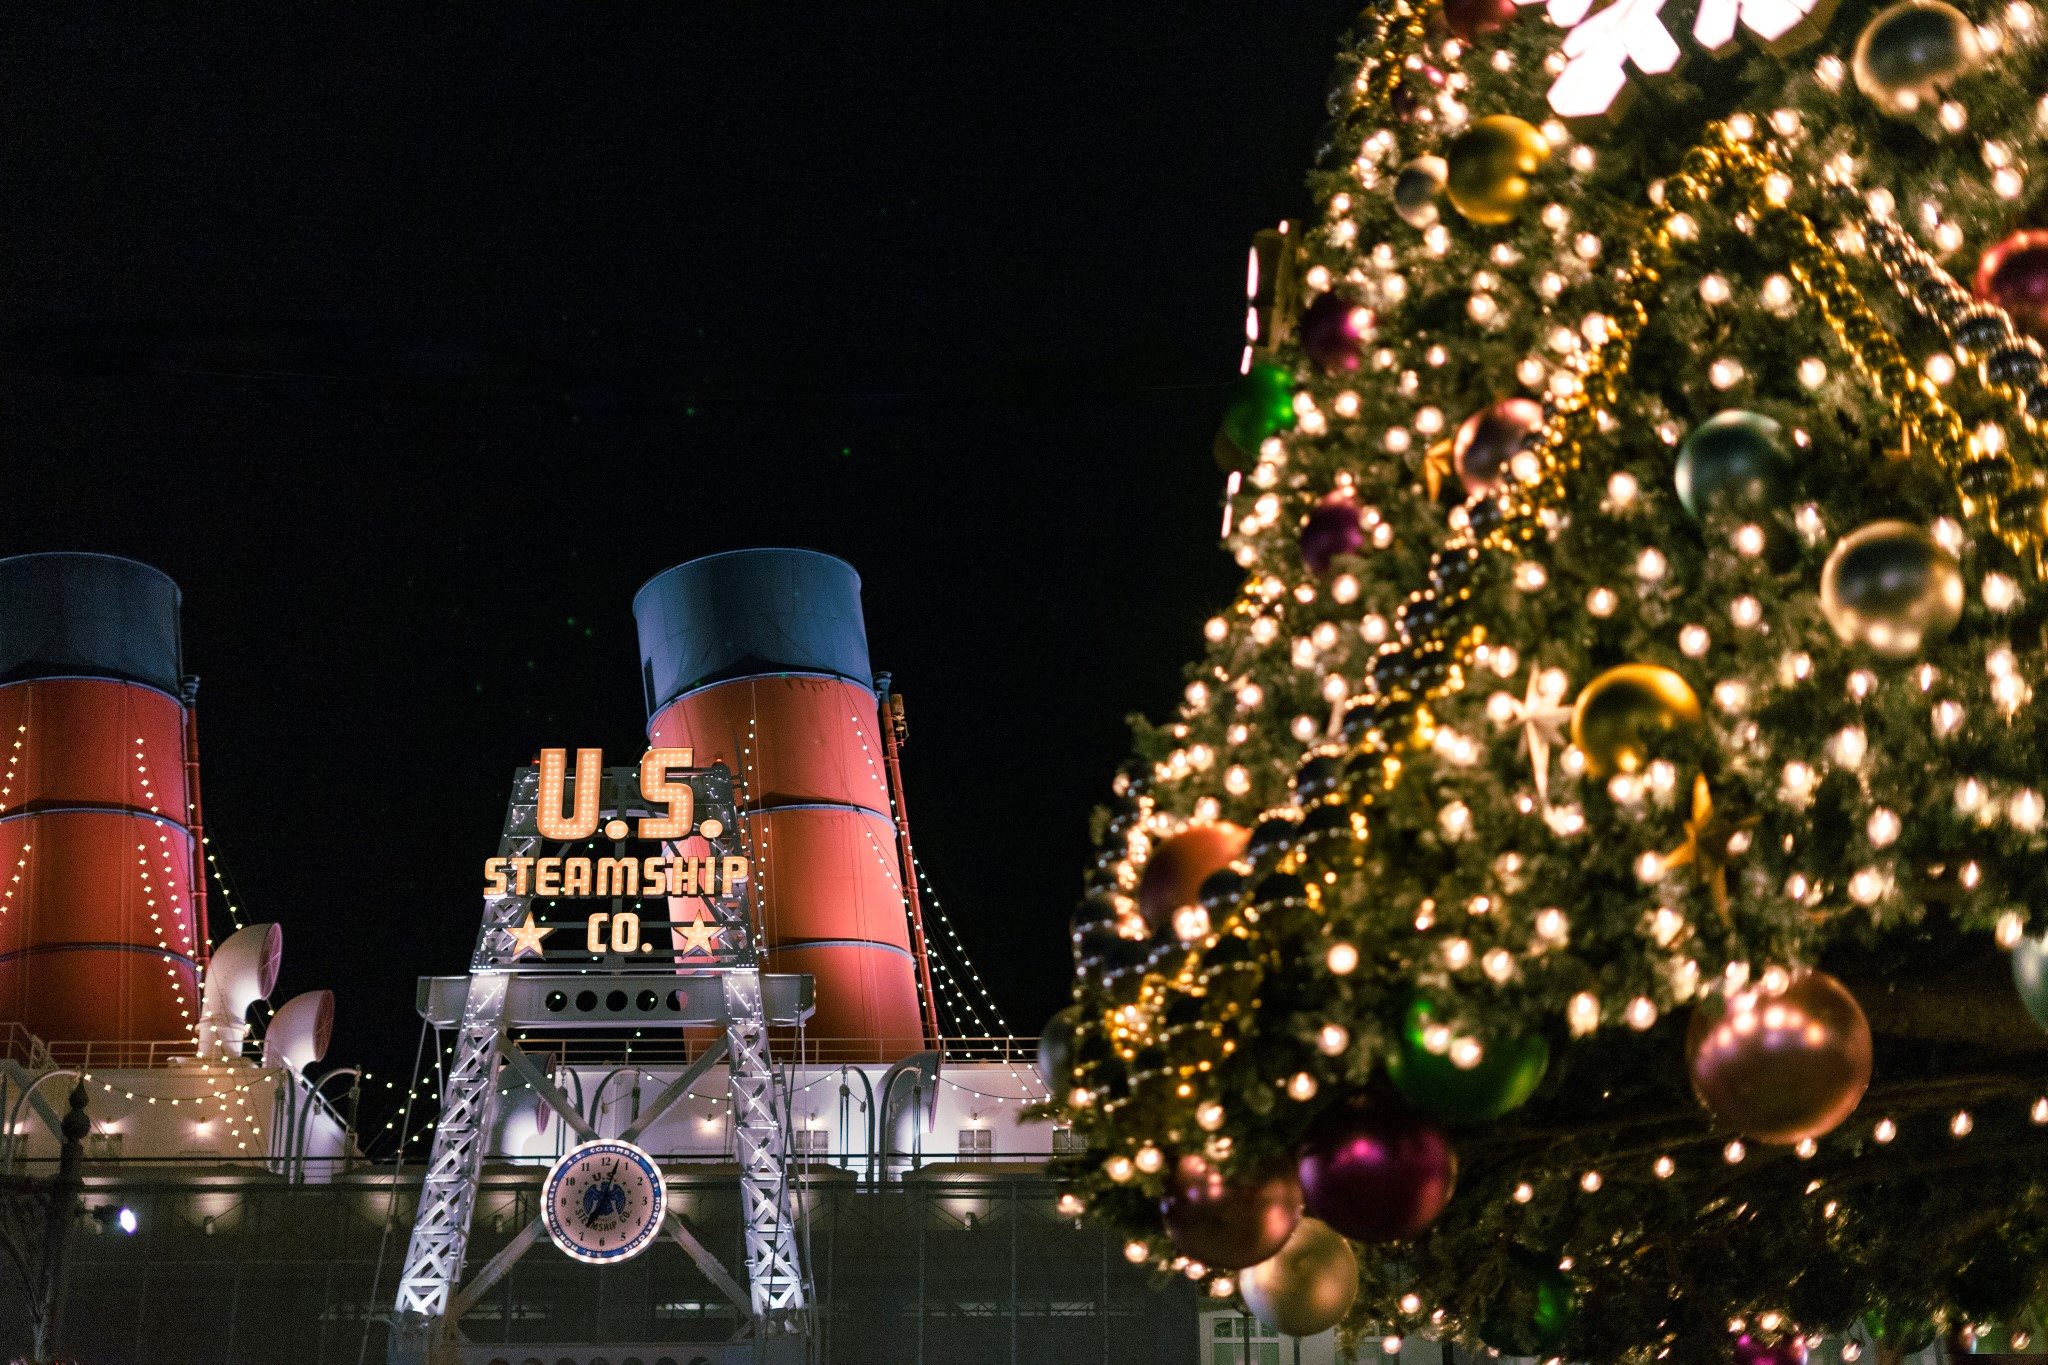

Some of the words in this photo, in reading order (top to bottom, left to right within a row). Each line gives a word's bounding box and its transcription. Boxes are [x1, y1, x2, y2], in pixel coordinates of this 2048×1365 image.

[536, 747, 723, 840] U.S.
[484, 856, 749, 896] STEAMSHIP
[587, 912, 654, 954] CO.
[567, 1153, 585, 1166] S.S.
[589, 1146, 641, 1161] COLUMBIA
[601, 1157, 611, 1166] 12
[624, 1162, 629, 1170] 1
[581, 1163, 590, 1171] 11
[565, 1177, 575, 1186] 10
[637, 1177, 643, 1186] 2
[561, 1198, 567, 1207] 9
[641, 1196, 648, 1205] 3
[565, 1217, 571, 1226] 8
[575, 1208, 617, 1232] STEMSHIP
[635, 1217, 641, 1226] 4
[623, 1197, 661, 1253] HOUSATONIC
[578, 1232, 585, 1241] 7
[620, 1232, 626, 1241] 5
[599, 1238, 605, 1247] 6
